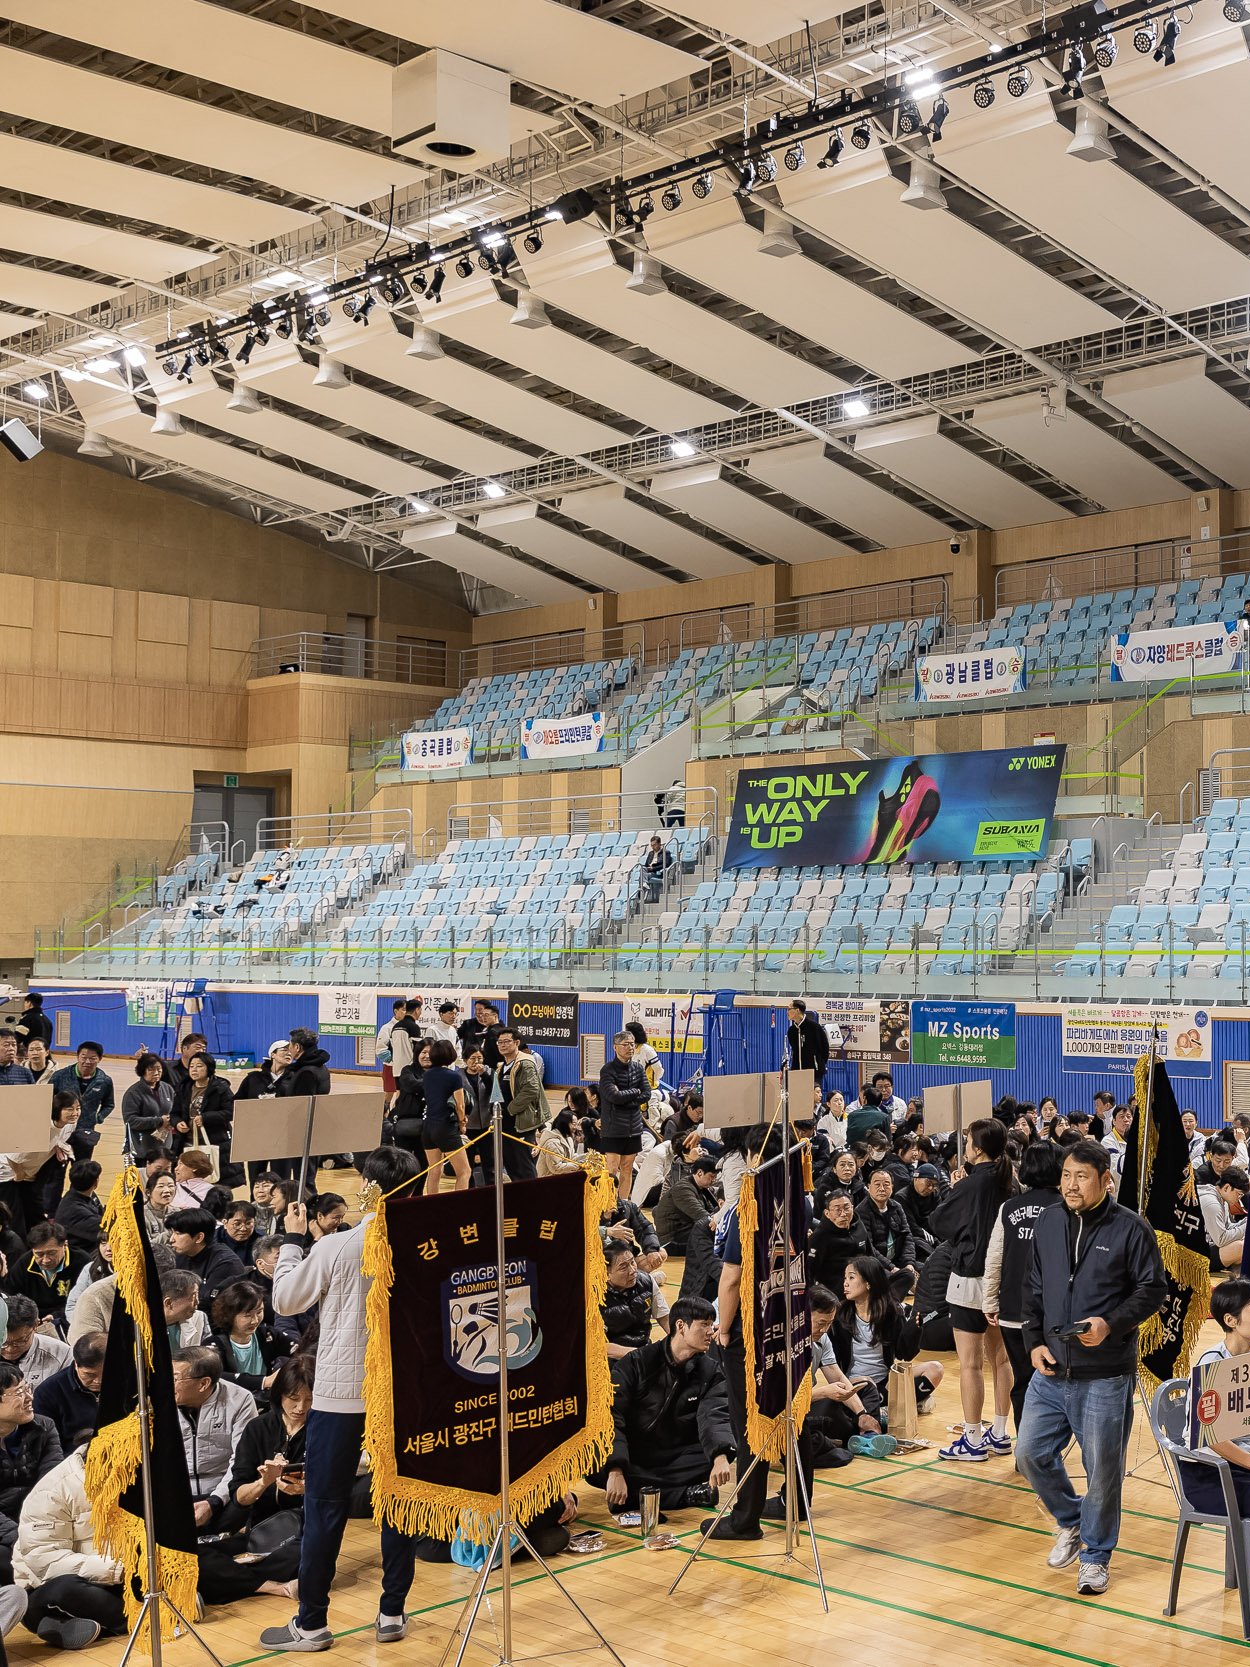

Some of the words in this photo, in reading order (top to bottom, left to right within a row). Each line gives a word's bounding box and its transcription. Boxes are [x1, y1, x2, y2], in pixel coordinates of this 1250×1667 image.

[945, 658, 994, 685] 광남클럽
[1011, 658, 1020, 673] 승
[421, 737, 452, 757] 중곡클럽
[1026, 755, 1056, 770] YONEX
[748, 779, 768, 788] THE
[767, 771, 869, 799] ONLY
[744, 799, 830, 825] WAY
[751, 825, 803, 849] UP
[825, 1001, 844, 1010] 경복궁
[830, 1030, 841, 1039] 22
[928, 1021, 948, 1038] MZ
[953, 1022, 1000, 1042] Sports
[1121, 1029, 1143, 1042] 응원의
[457, 1281, 498, 1295] BADMINTO
[454, 1393, 497, 1414] SINCE
[1201, 1394, 1216, 1419] 필
[403, 1428, 449, 1455] 서울시
[453, 1417, 497, 1446] 광진구
